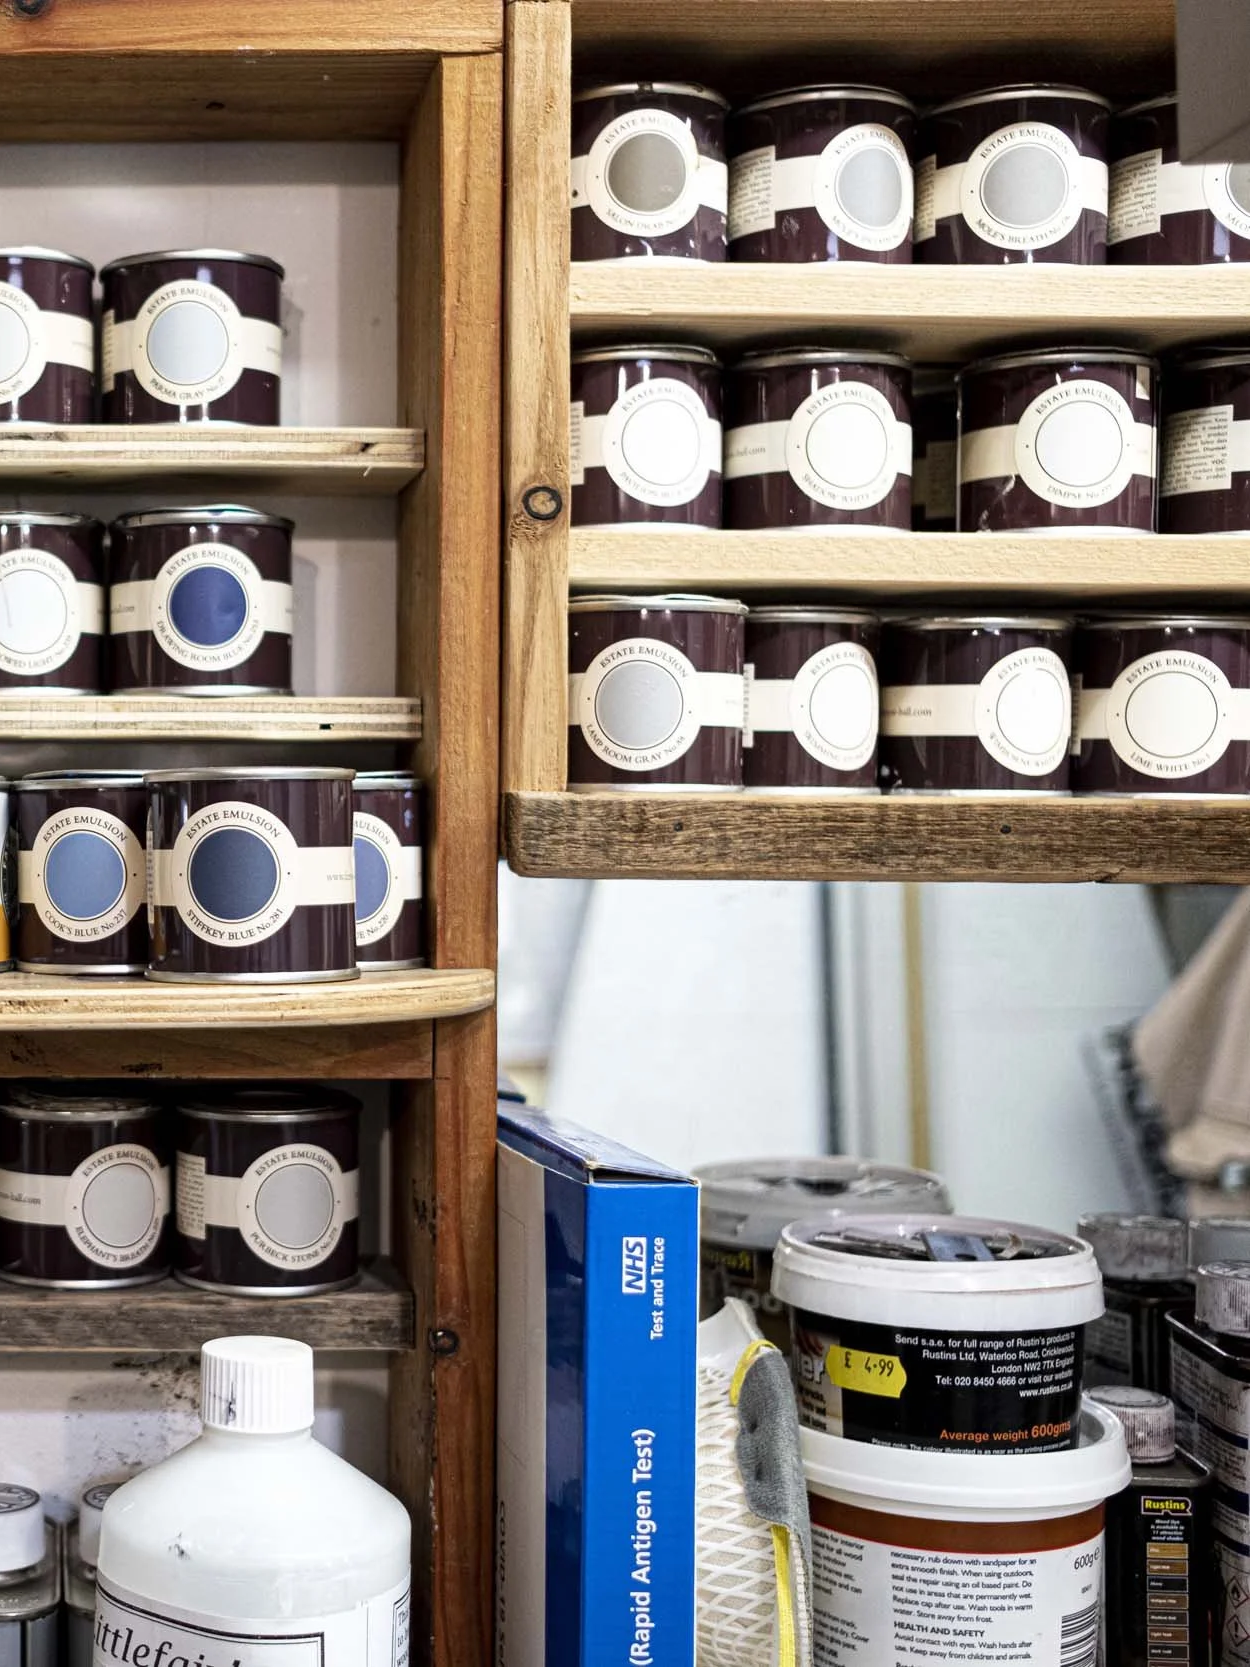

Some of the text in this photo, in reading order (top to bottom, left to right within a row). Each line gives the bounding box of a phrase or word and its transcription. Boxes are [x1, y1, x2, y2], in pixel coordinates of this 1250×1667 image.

[165, 550, 199, 576] ESTATE
[598, 645, 688, 679] ESTATE EMULSION
[1124, 658, 1162, 684] ESTATE
[584, 722, 604, 748] LAMP
[601, 743, 632, 763] ROOM
[41, 813, 127, 843] ESTATE EMULSION
[184, 808, 281, 840] ESTATE EMULSION
[43, 907, 127, 937] COOK'S BLUE No.237
[185, 906, 283, 940] STIFFKEY BLUE No.281
[81, 1151, 114, 1177] ESTATE
[254, 1149, 334, 1176] ESTATE EMULSION
[249, 1231, 320, 1263] PURBECK STONE
[624, 1239, 644, 1291] NHS
[650, 1236, 665, 1341] Test and Trace
[895, 1334, 919, 1345] Send
[948, 1339, 962, 1347] for
[963, 1339, 977, 1348] full
[980, 1339, 1004, 1350] range
[1006, 1338, 1015, 1347] of
[1016, 1336, 1045, 1347] Rustin's
[844, 1351, 852, 1368] £
[922, 1349, 1039, 1362] Rustins Ltd, Waterloo Road,
[991, 1363, 1022, 1374] London
[1024, 1362, 1041, 1372] NW2
[1042, 1360, 1055, 1370] 7TX
[935, 1375, 952, 1385] Tel:
[954, 1376, 971, 1386] 020
[973, 1376, 994, 1386] 8450
[1018, 1377, 1026, 1385] or
[1027, 1374, 1042, 1384] visit
[1043, 1372, 1053, 1383] our
[940, 1420, 1071, 1444] Average weight 600gms
[1144, 1499, 1187, 1511] Rustins
[629, 1428, 657, 1666] (Rapid Antigen Test)
[928, 1556, 941, 1564] rub
[942, 1556, 963, 1565] down
[964, 1557, 981, 1566] with
[982, 1558, 1017, 1567] sandpaper
[1018, 1557, 1029, 1565] for
[893, 1620, 985, 1637] HEALTH AND SAFETY
[894, 1631, 914, 1642] Avoid
[915, 1635, 941, 1646] contact
[942, 1637, 958, 1647] with
[977, 1641, 997, 1649] Wash
[998, 1641, 1017, 1649] hands
[1018, 1640, 1032, 1648] after
